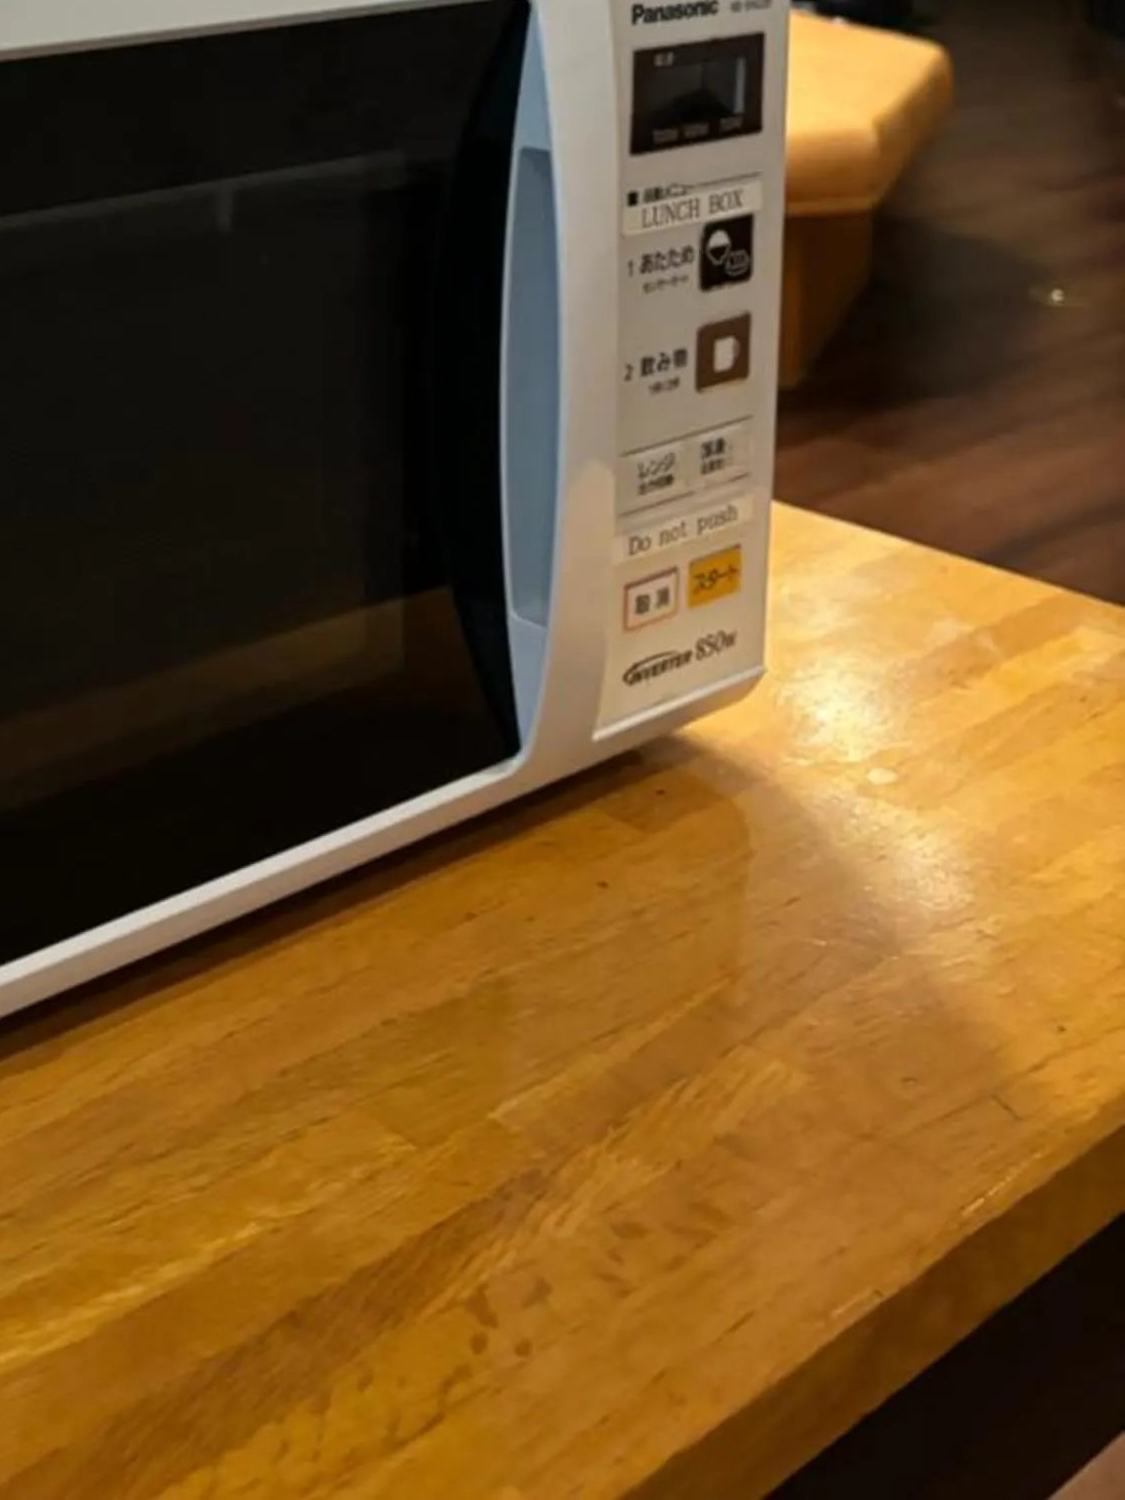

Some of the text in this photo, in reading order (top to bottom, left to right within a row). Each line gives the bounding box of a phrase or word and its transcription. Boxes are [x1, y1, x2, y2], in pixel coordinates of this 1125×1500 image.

[641, 197, 700, 228] LUNCH
[708, 188, 744, 214] BOX
[640, 244, 694, 274] あたため
[628, 504, 738, 556] Do not push
